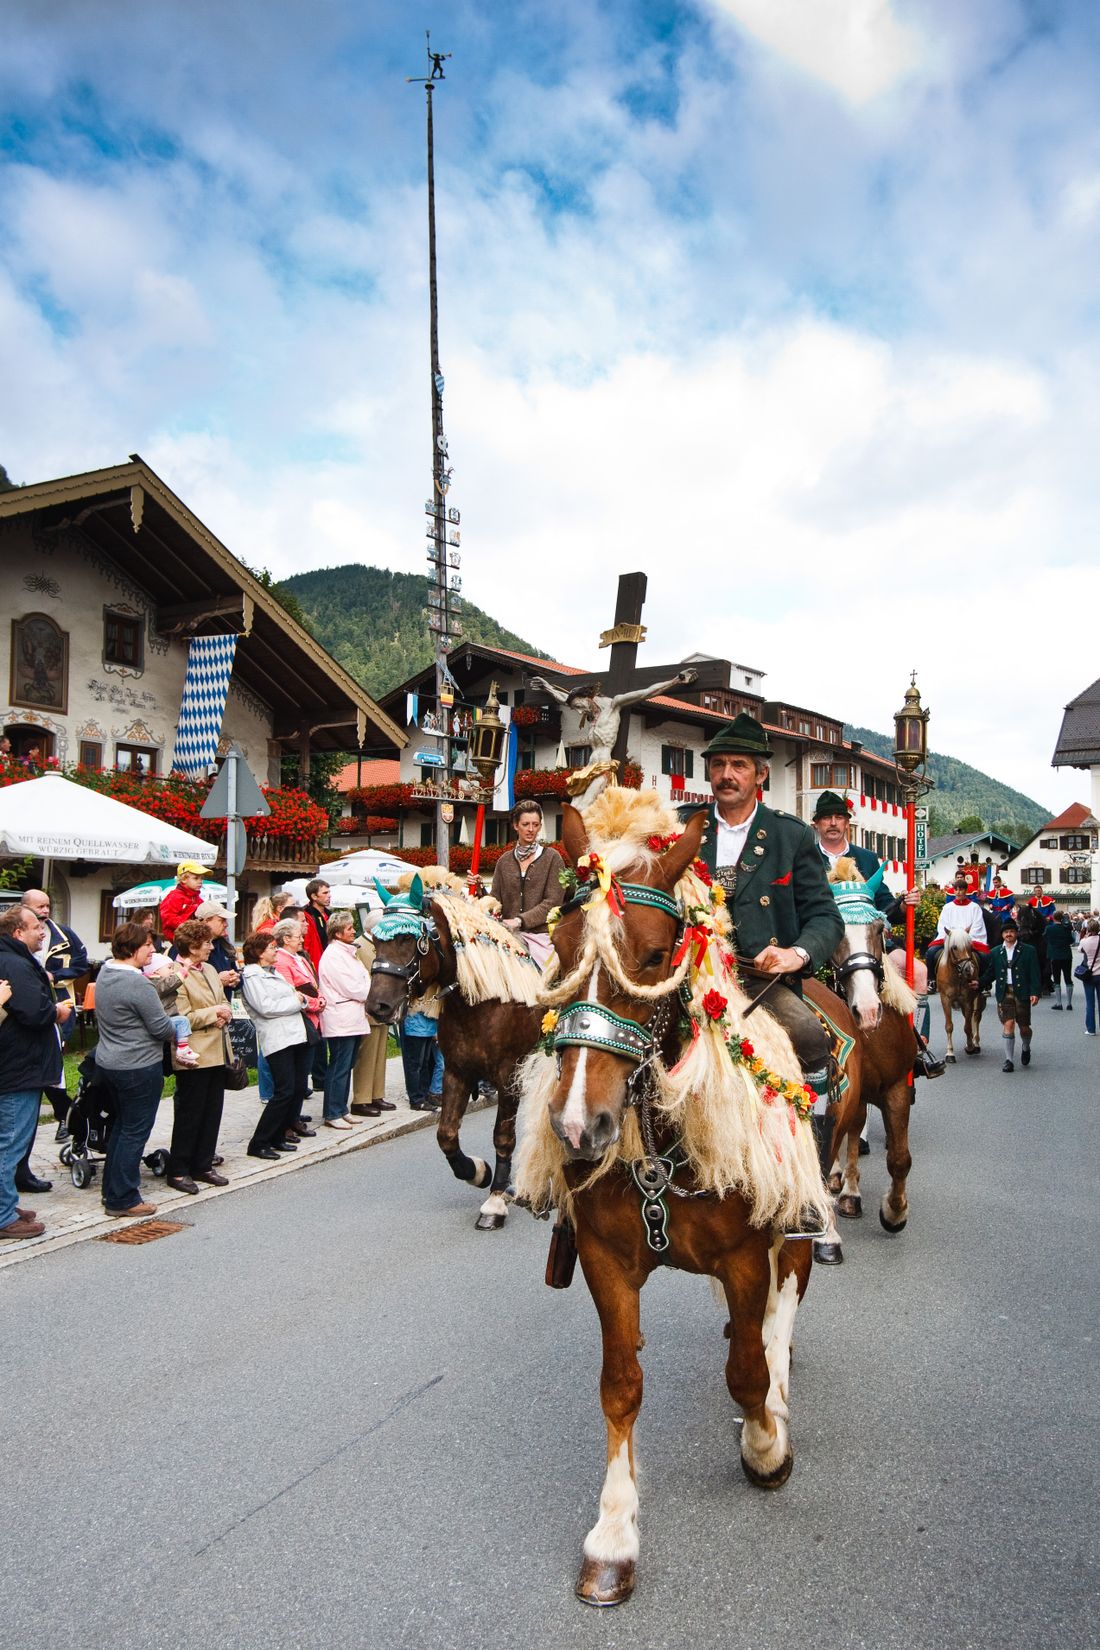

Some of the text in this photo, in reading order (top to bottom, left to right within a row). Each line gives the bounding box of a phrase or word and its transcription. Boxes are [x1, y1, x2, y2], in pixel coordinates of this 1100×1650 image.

[18, 835, 140, 849] MIT REINEM QUELLWASSER
[917, 825, 925, 858] HOTEL
[76, 848, 119, 857] GEBRAUT
